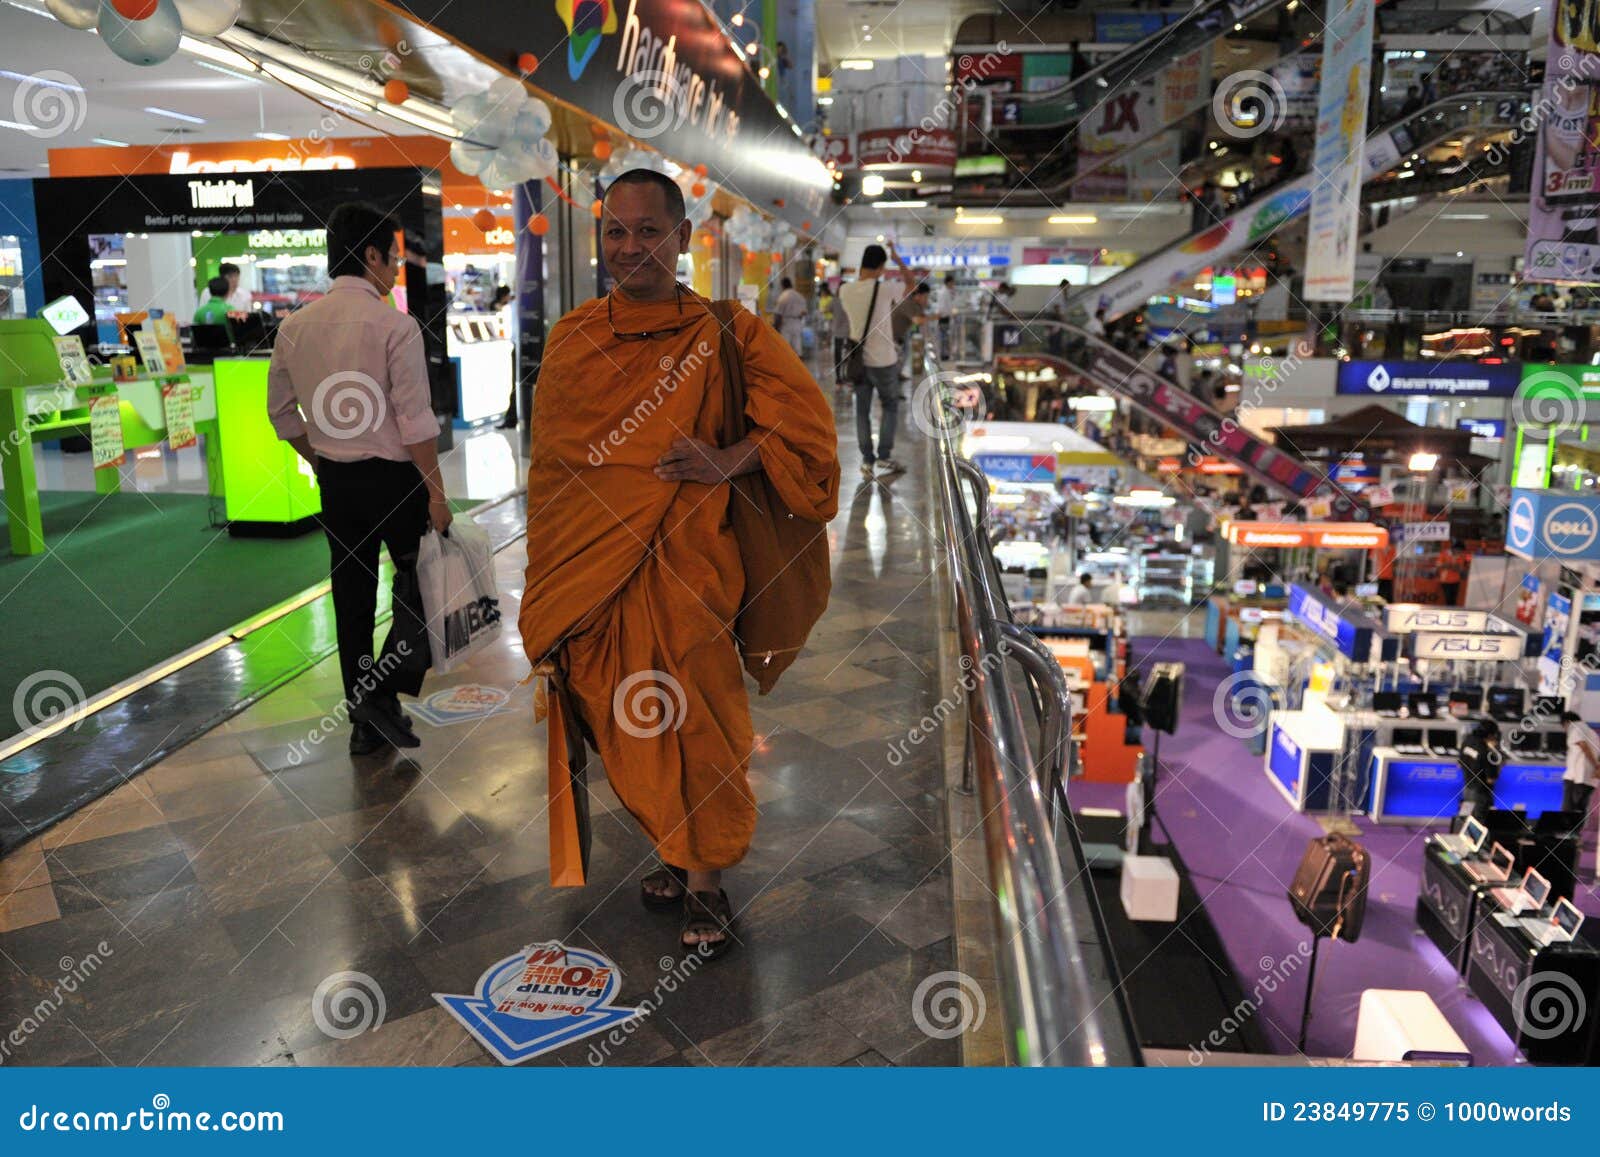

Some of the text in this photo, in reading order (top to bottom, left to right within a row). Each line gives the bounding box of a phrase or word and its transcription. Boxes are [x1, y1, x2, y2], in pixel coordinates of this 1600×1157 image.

[188, 179, 254, 209] ThinkPad
[145, 212, 303, 226] Better PC experience with Intel Inside
[1549, 520, 1592, 537] DELL
[1404, 612, 1469, 627] ASUS
[1431, 637, 1501, 653] ASUS
[516, 984, 604, 998] PANTIP
